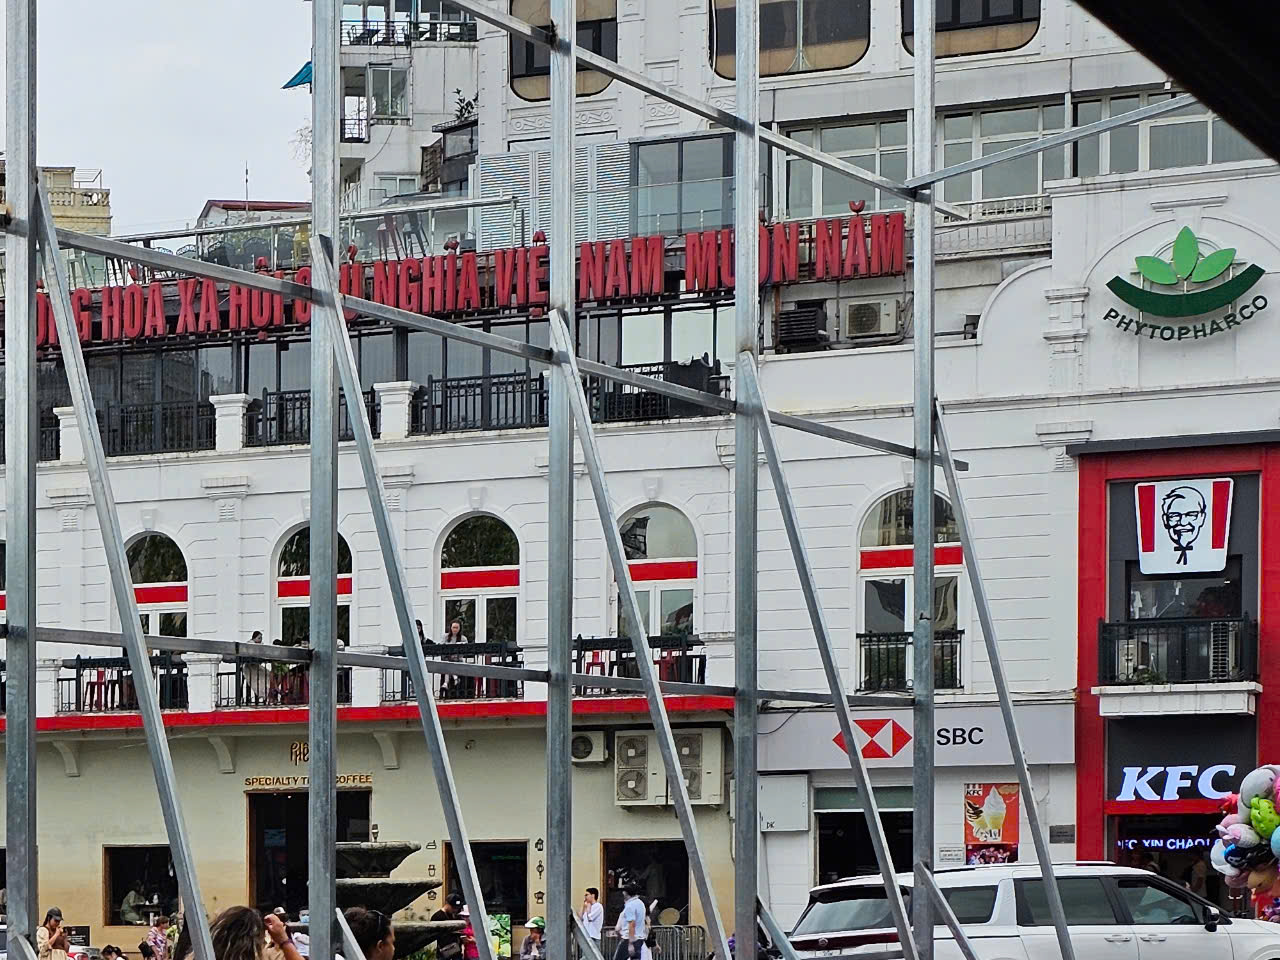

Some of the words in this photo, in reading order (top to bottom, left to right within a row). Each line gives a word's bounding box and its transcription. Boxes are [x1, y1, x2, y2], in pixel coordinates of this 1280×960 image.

[578, 236, 665, 301] NAM
[815, 199, 907, 280] NĂM
[1103, 295, 1268, 341] PHYTOPHARCO
[1115, 764, 1237, 801] KFC
